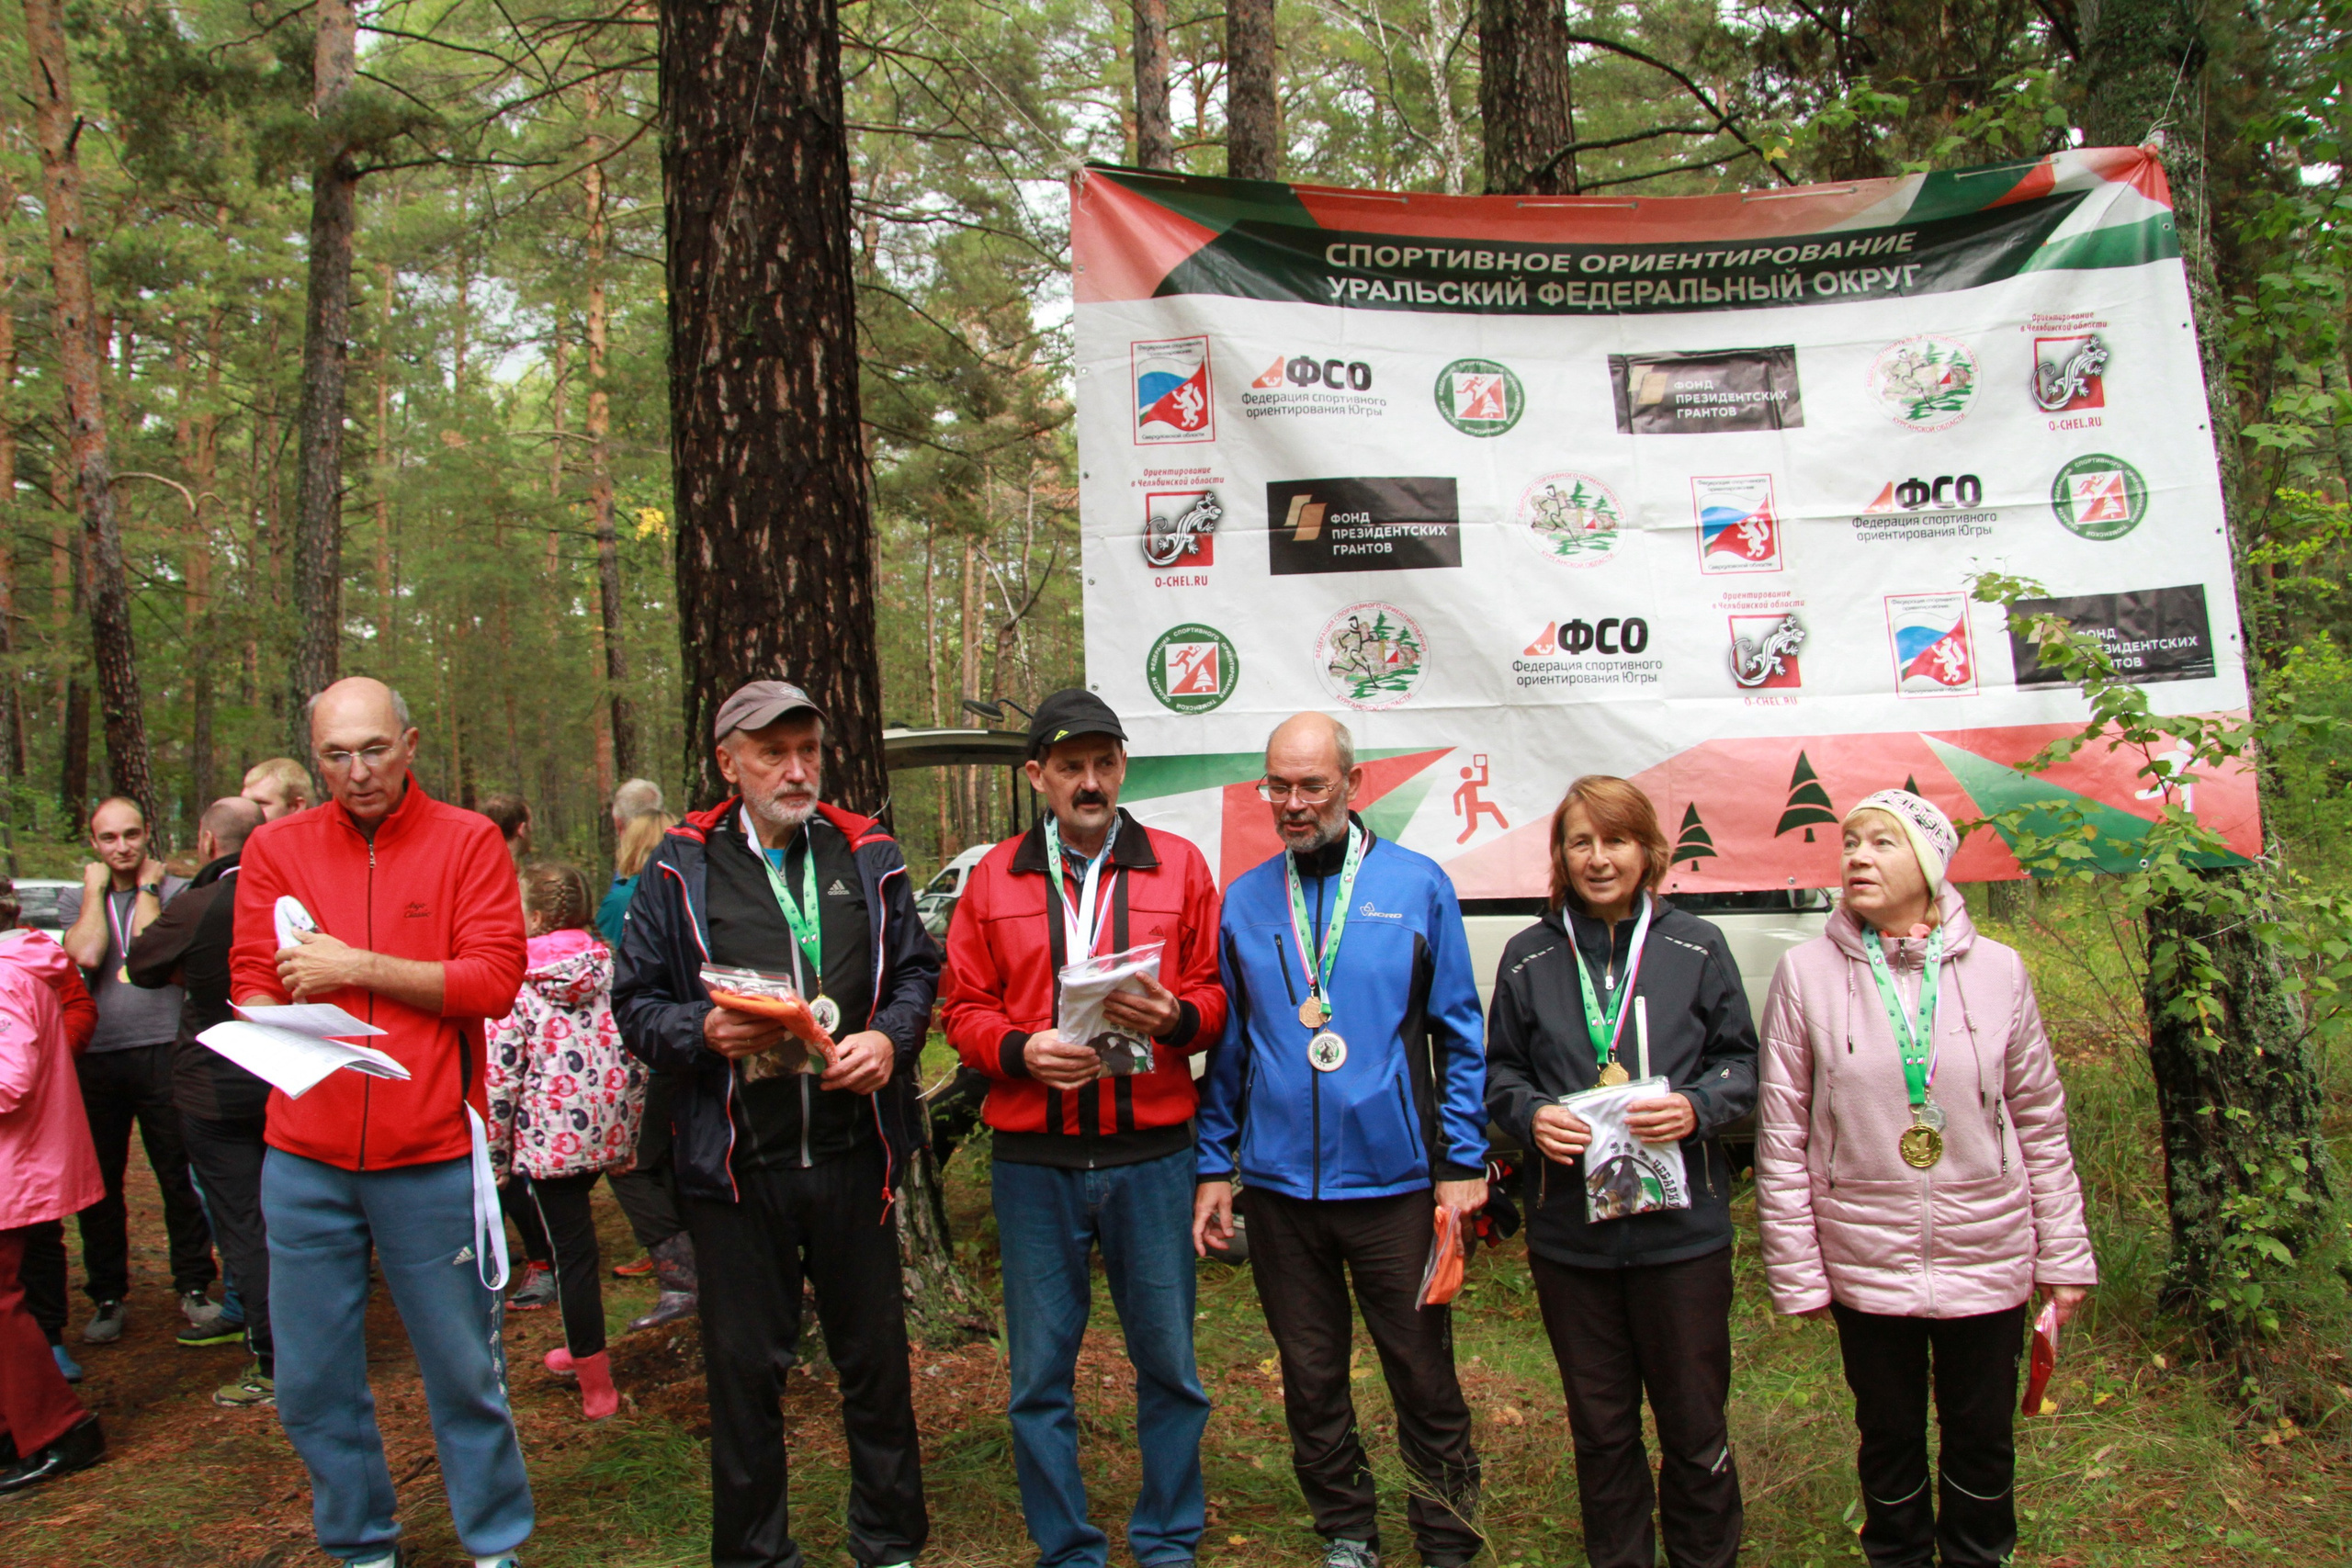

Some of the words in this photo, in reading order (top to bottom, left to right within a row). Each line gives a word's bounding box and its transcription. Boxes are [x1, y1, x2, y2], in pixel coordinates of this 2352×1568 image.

[1326, 243, 1571, 274] СПОРТИВНОЕ
[1579, 231, 1917, 274] ОРИЕНТИРОВАНИЕ
[1326, 276, 1528, 306] УРАЛЬСКИЙ
[1537, 267, 1804, 310] ФЕДЕРАЛЬНЫЙ
[1813, 264, 1921, 296] ОКРУГ
[1286, 355, 1372, 391] ФСО
[1674, 379, 1713, 390] ФОНД
[1241, 392, 1309, 405] Федерация
[1312, 393, 1386, 406] спортивного
[1676, 389, 1788, 404] ПРЕЗИДЕНТСКИХ
[1246, 405, 1345, 420] ориентирования
[1348, 404, 1382, 417] Югры
[1677, 407, 1736, 419] ГРАНТОВ
[2048, 416, 2102, 431] O-CHEL.RU
[1143, 467, 1211, 477] Ориентирование
[1137, 477, 1188, 487] Челябинской
[1190, 476, 1225, 485] области
[1894, 474, 1983, 511] ФСО
[1330, 512, 1371, 524] ФОНД
[1852, 516, 1919, 530] Федерация
[1922, 513, 1997, 526] спортивного
[1332, 525, 1447, 539] ПРЕЗИДЕНТСКИХ
[1857, 527, 1955, 543] ориентирования
[1958, 525, 1992, 538] Югры
[1333, 542, 1393, 555] ГРАНТОВ
[1155, 575, 1208, 588] O-CHEL.RU
[1173, 626, 1219, 641] СПОРТИВНОГО
[1557, 617, 1648, 655] ФСО
[1512, 660, 1582, 673] Федерация
[1585, 660, 1662, 674] спортивного
[1517, 673, 1619, 688] ориентирования
[1623, 671, 1657, 685] Югры
[1744, 696, 1798, 707] O-CHEL.RU
